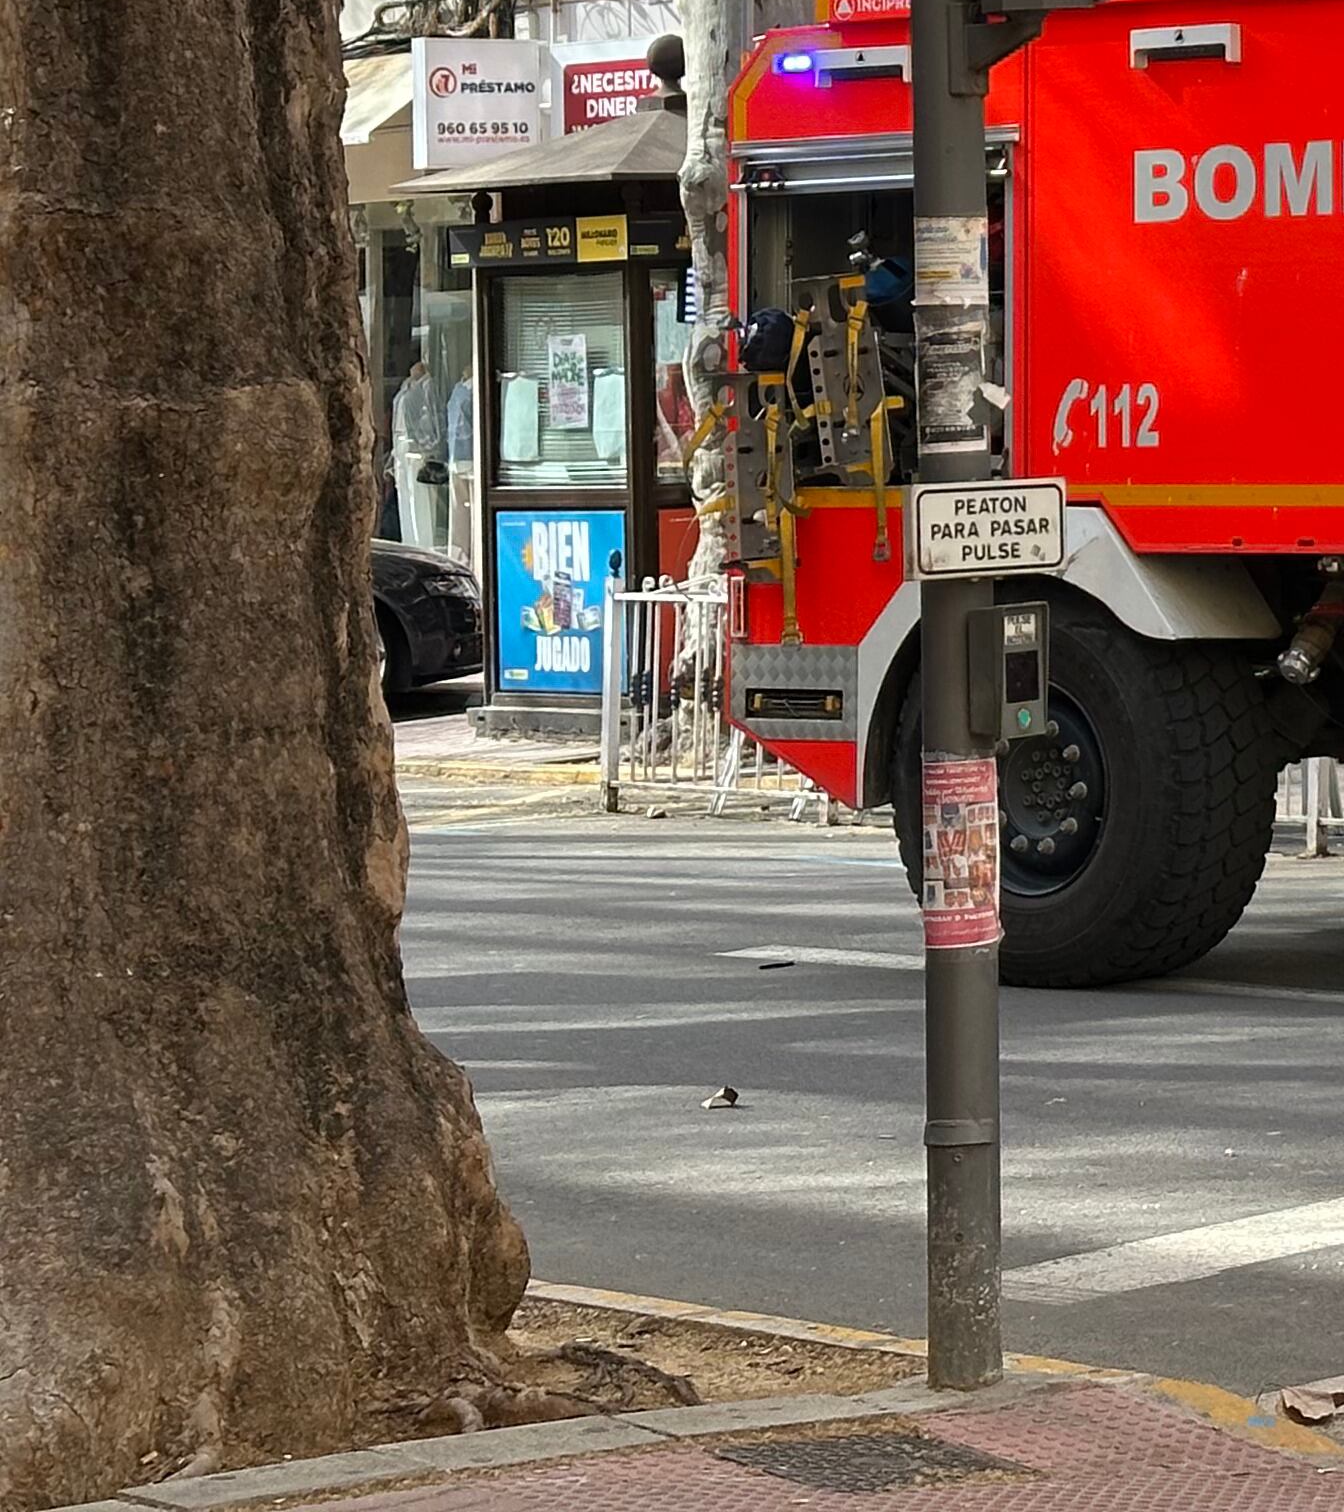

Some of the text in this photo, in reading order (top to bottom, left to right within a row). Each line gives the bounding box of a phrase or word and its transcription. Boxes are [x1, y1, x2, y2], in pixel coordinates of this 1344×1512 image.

[460, 80, 536, 94] PRÉSTAMO
[586, 95, 640, 119] DINER
[437, 122, 529, 135] 960 65 95 10
[1090, 382, 1160, 449] 112
[954, 496, 1028, 516] PEATON
[930, 517, 1050, 541] PARA PASAR
[531, 520, 591, 582] BIEN
[961, 542, 1022, 562] PULSE
[534, 635, 591, 673] JUGADO
